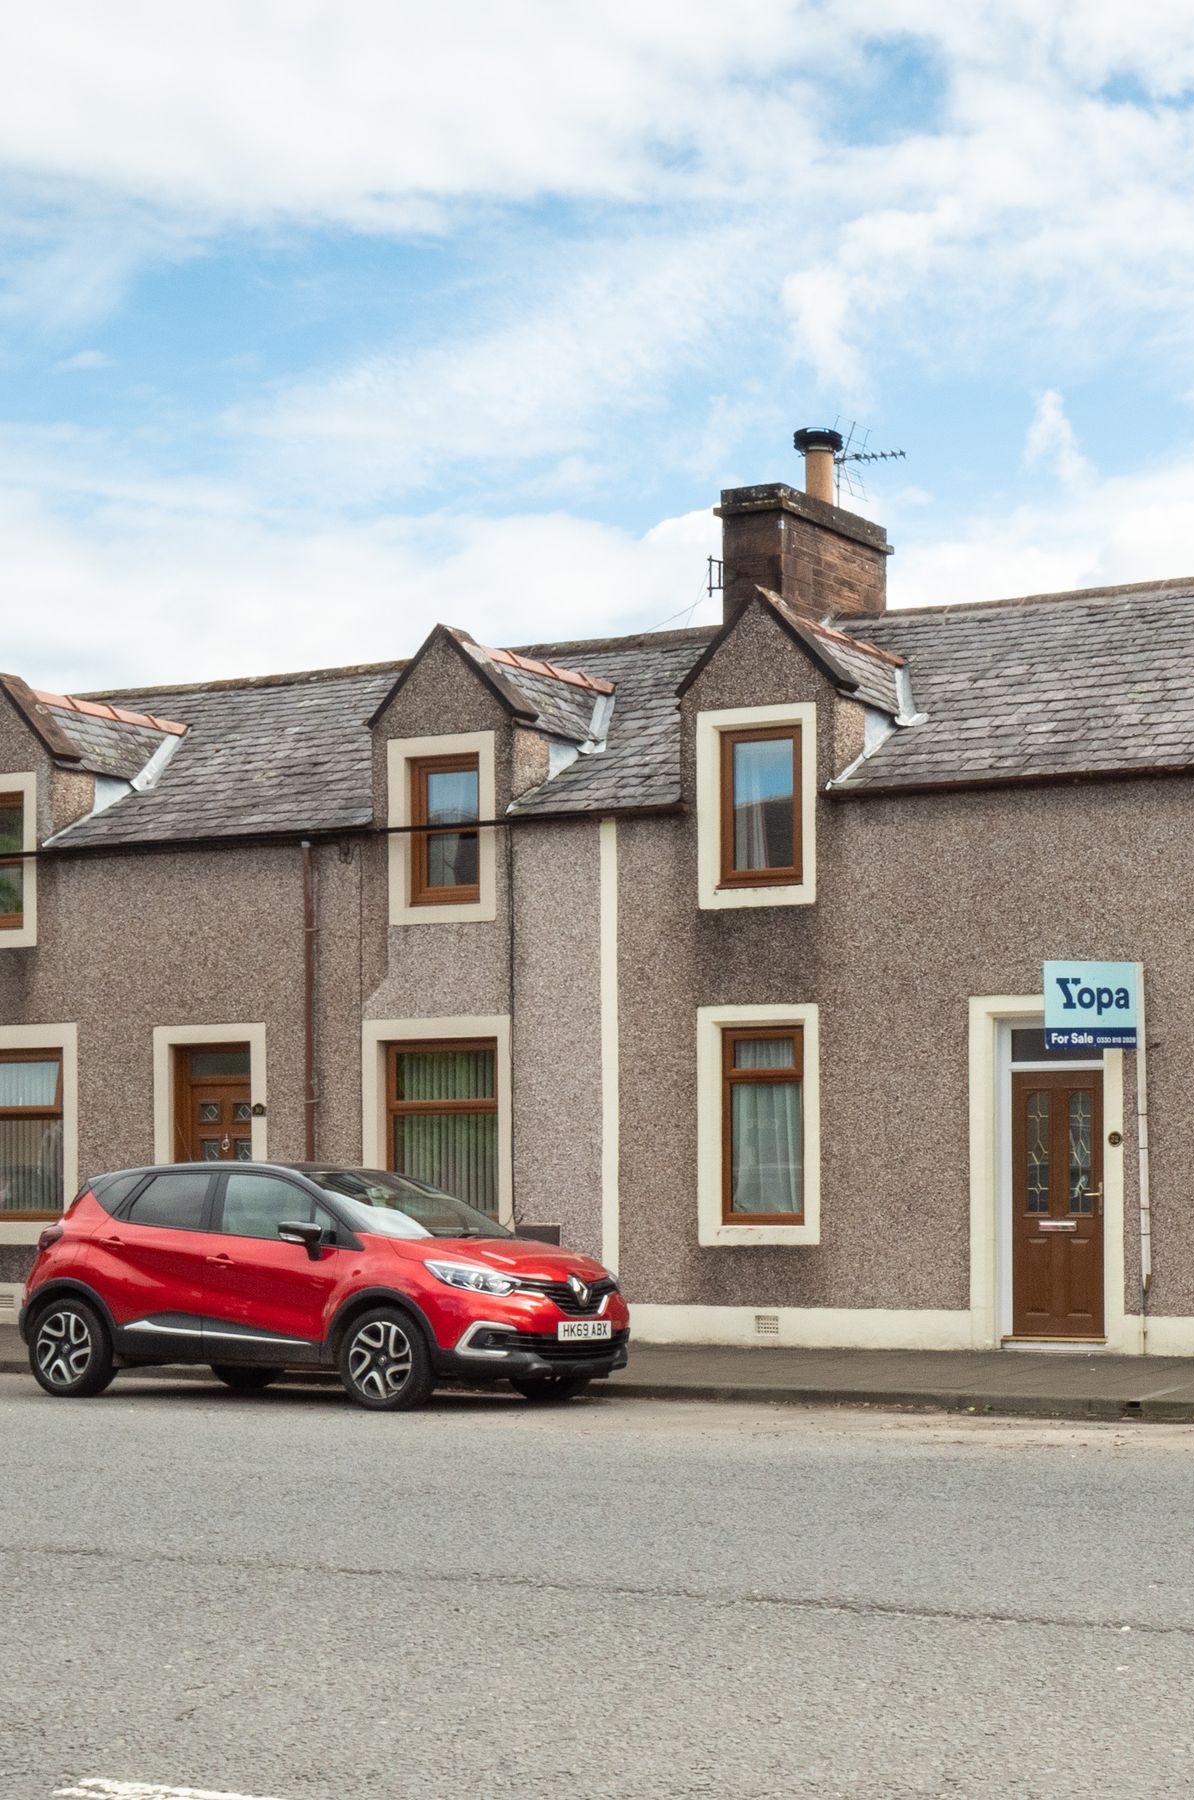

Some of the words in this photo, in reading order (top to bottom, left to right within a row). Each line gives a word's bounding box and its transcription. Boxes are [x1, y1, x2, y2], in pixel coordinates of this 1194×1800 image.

[1056, 977, 1130, 1016] Yopa
[1051, 1033, 1069, 1044] For
[1071, 1032, 1094, 1044] Sale
[563, 1323, 589, 1337] HK69
[592, 1322, 608, 1336] ABX
